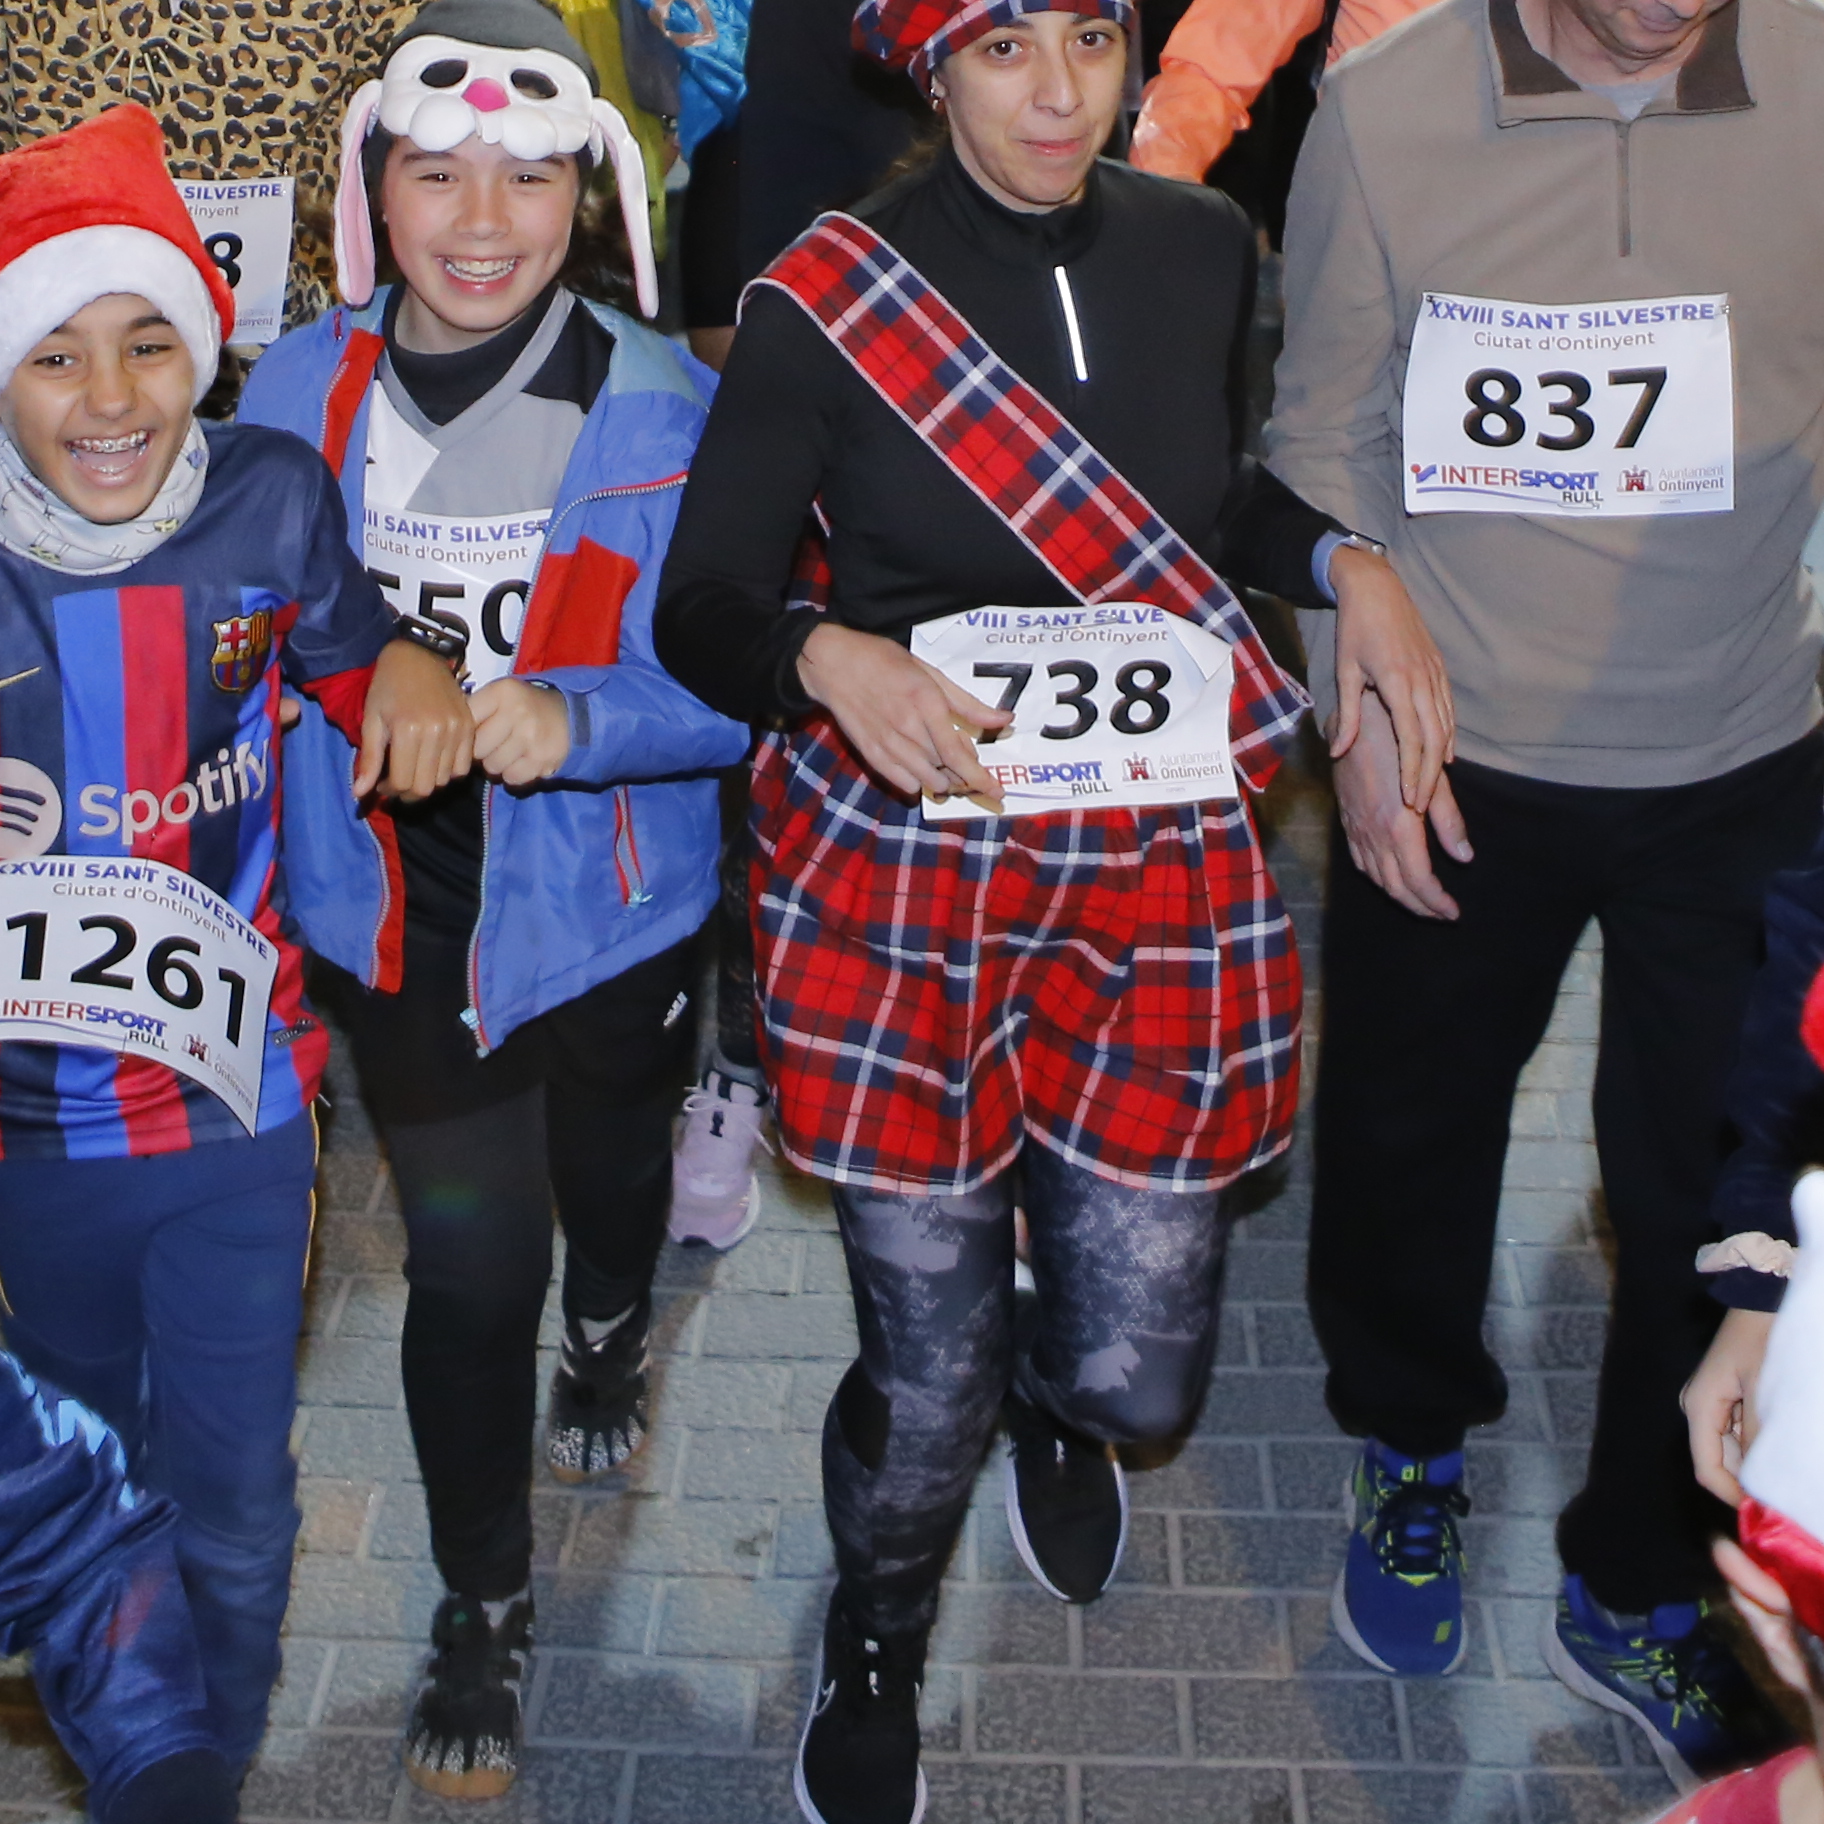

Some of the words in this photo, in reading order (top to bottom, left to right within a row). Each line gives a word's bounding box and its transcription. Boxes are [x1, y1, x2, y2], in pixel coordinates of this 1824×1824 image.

[184, 183, 282, 200] SILVESTRE
[189, 205, 239, 219] tinyent
[1428, 301, 1494, 325] XXVIII
[1500, 309, 1570, 330] SANT
[1577, 302, 1714, 330] SILVESTRE
[1474, 331, 1532, 350] Ciutat
[1538, 331, 1656, 352] d'Ontinyent
[1462, 365, 1669, 451] 837
[1440, 464, 1599, 491] INTERSPORT
[1658, 477, 1725, 493] Ontinyent
[1562, 490, 1604, 504] RULL
[384, 514, 442, 541] SANT
[449, 519, 550, 545] SILVEST
[365, 532, 411, 557] Ciutat
[415, 544, 528, 565] d'Ontinyent
[955, 609, 1008, 629] VIII
[1016, 611, 1088, 630] SANT
[1093, 607, 1166, 625] SILVE
[985, 630, 1045, 645] Ciutat
[1051, 628, 1169, 646] d'Ontinyent
[972, 659, 1173, 745] 738
[982, 761, 1103, 787] TERSPORT
[1159, 762, 1226, 779] Ontinyent
[78, 736, 269, 846] Spotify
[1070, 781, 1113, 796] RULL
[52, 882, 116, 899] Ciutat
[123, 884, 227, 944] d'Ontinyent
[84, 862, 160, 883] SANT
[165, 876, 269, 961] SILVESTRE
[5, 910, 246, 1049] 1261
[1, 998, 169, 1038] INTERSPORT
[128, 1029, 170, 1053] RULL
